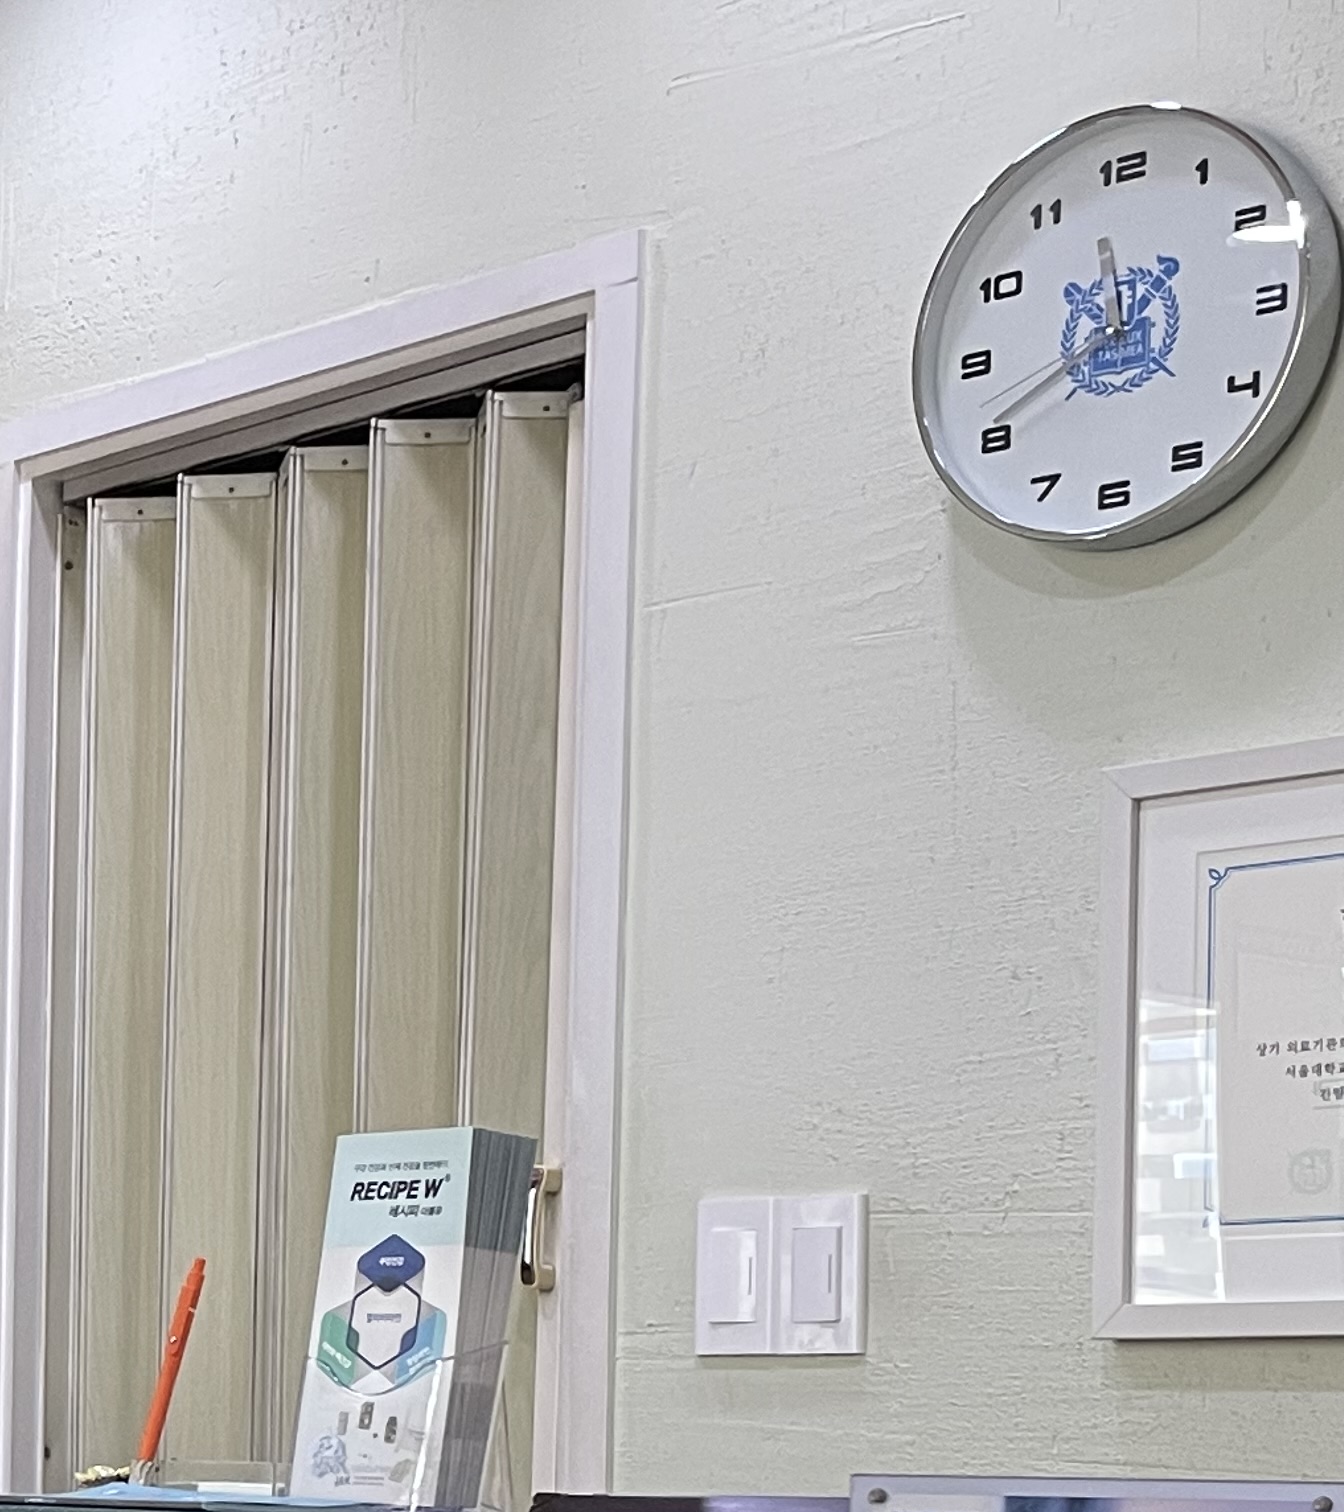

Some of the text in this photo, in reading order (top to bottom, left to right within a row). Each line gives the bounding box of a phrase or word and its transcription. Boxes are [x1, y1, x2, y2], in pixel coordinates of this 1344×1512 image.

[1099, 151, 1147, 187] 12
[1195, 158, 1209, 184] 1
[1031, 199, 1062, 230] 11
[1234, 205, 1267, 232] 2
[979, 270, 1023, 303] 10
[1256, 282, 1288, 316] 3
[961, 349, 992, 379] 9
[1227, 370, 1261, 398] 4
[981, 424, 1012, 454] 8
[1171, 441, 1203, 472] 5
[1030, 473, 1062, 502] 7
[1098, 480, 1131, 510] 6
[1256, 1041, 1280, 1058] 상기
[350, 1180, 419, 1201] RECIPE
[389, 1205, 420, 1218] 레시피
